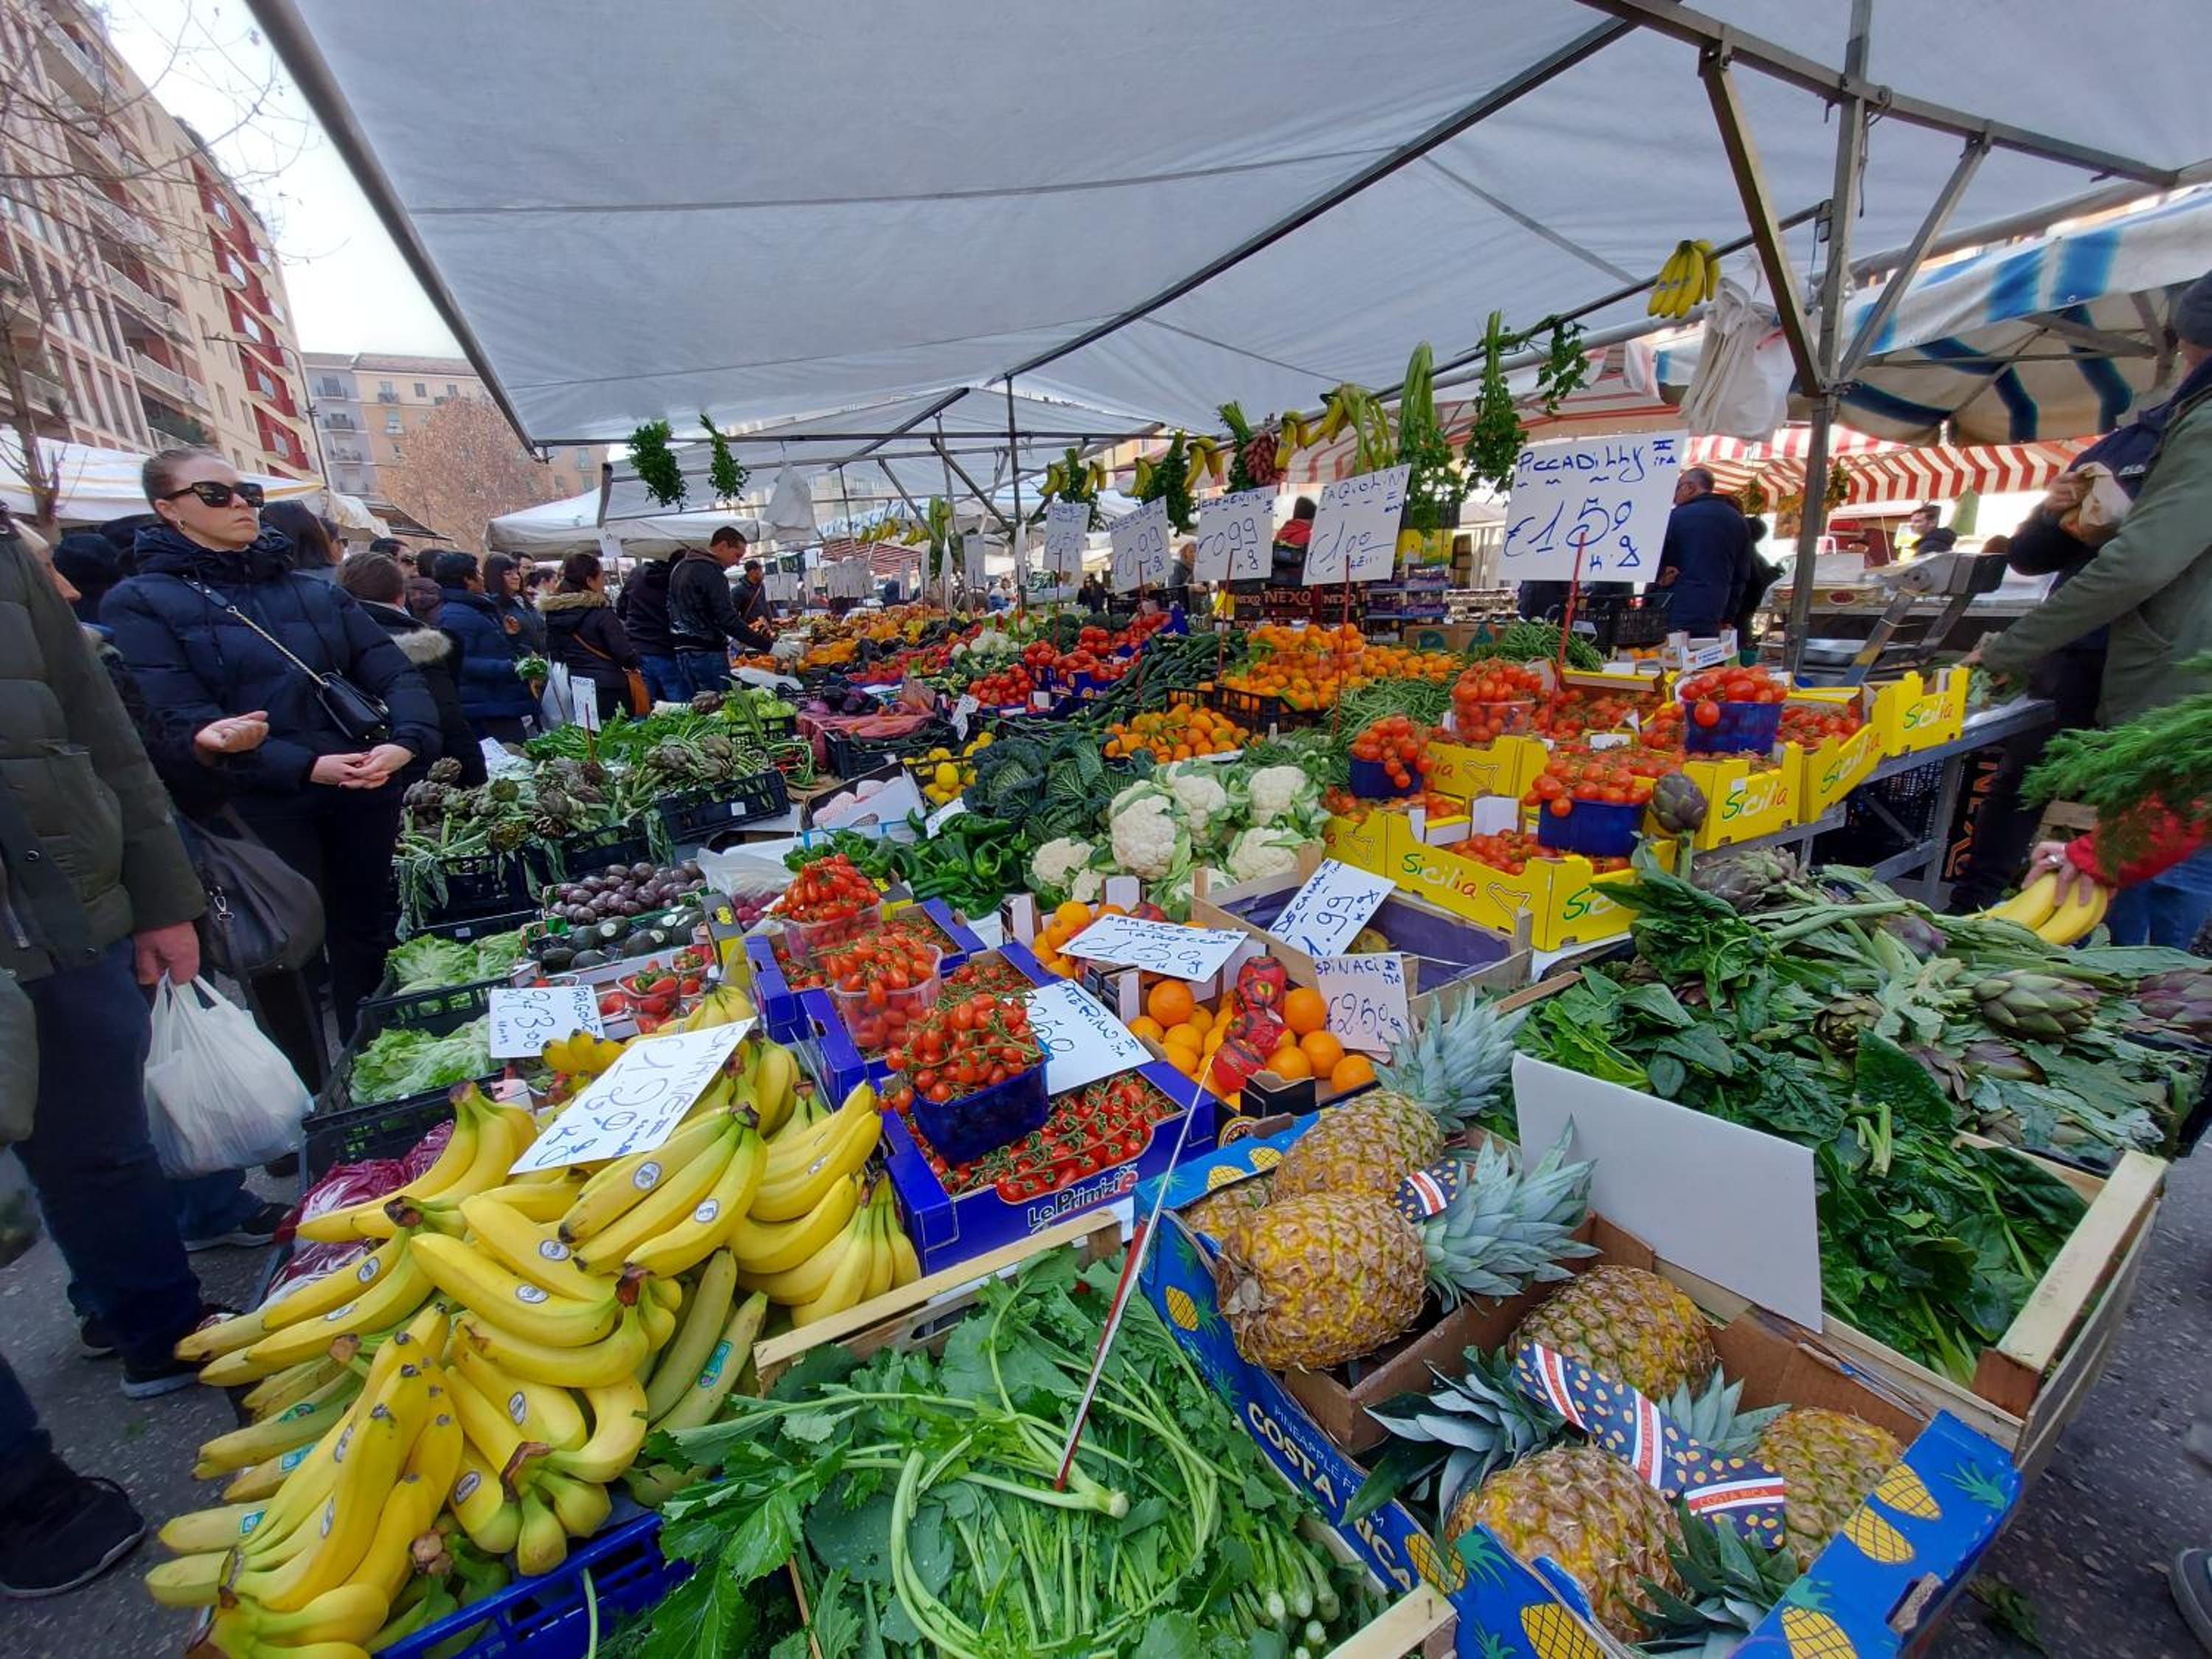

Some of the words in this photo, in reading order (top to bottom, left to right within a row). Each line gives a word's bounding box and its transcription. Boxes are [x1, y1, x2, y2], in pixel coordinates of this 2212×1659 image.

[1264, 591, 1312, 605] NEXO
[1902, 695, 1954, 729] Sicilia
[1820, 731, 1882, 794] Sicilia
[1722, 782, 1787, 821] Sicilia
[1402, 853, 1478, 897] Sicilia
[1248, 1402, 1337, 1509] COSTA
[1274, 1405, 1340, 1481] PINEAPPLE
[1699, 1492, 1733, 1506] COSTA
